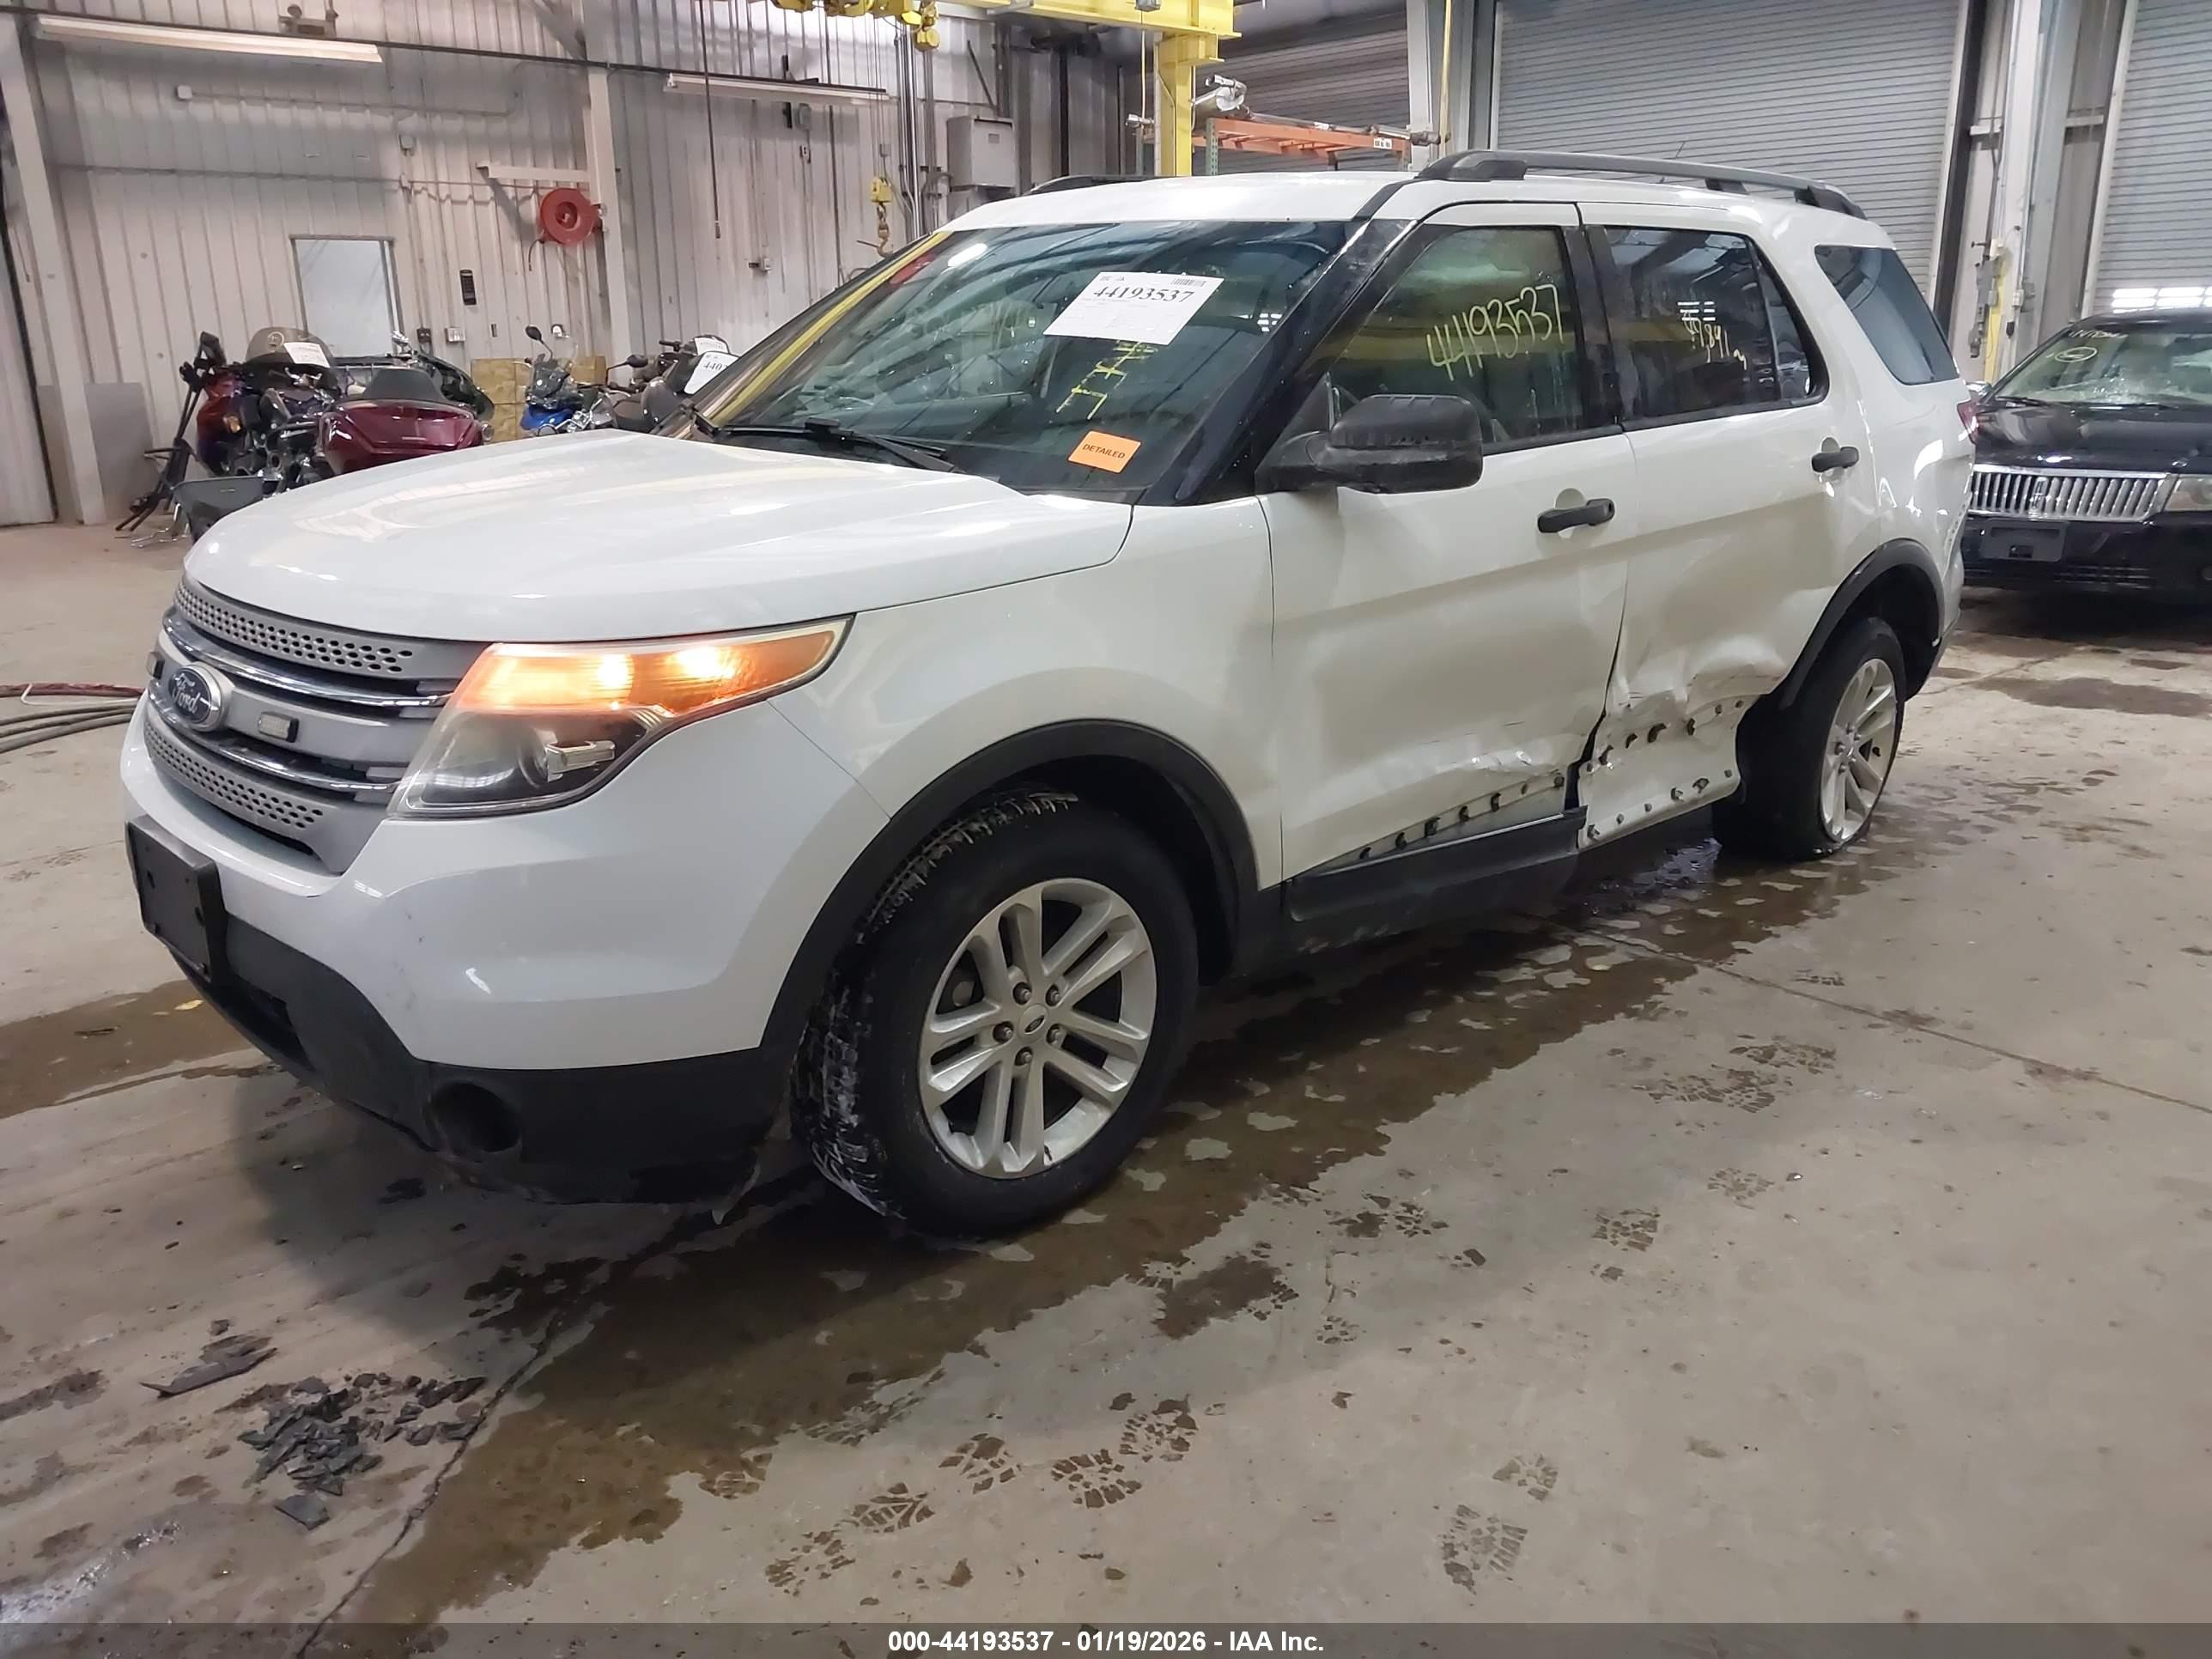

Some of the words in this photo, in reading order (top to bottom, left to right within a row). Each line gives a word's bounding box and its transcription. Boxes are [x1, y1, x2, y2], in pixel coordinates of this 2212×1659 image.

[1093, 285, 1195, 303] 44193537
[1426, 283, 1564, 381] 44193537
[1082, 443, 1126, 459] DETAILED
[172, 672, 201, 714] Ford
